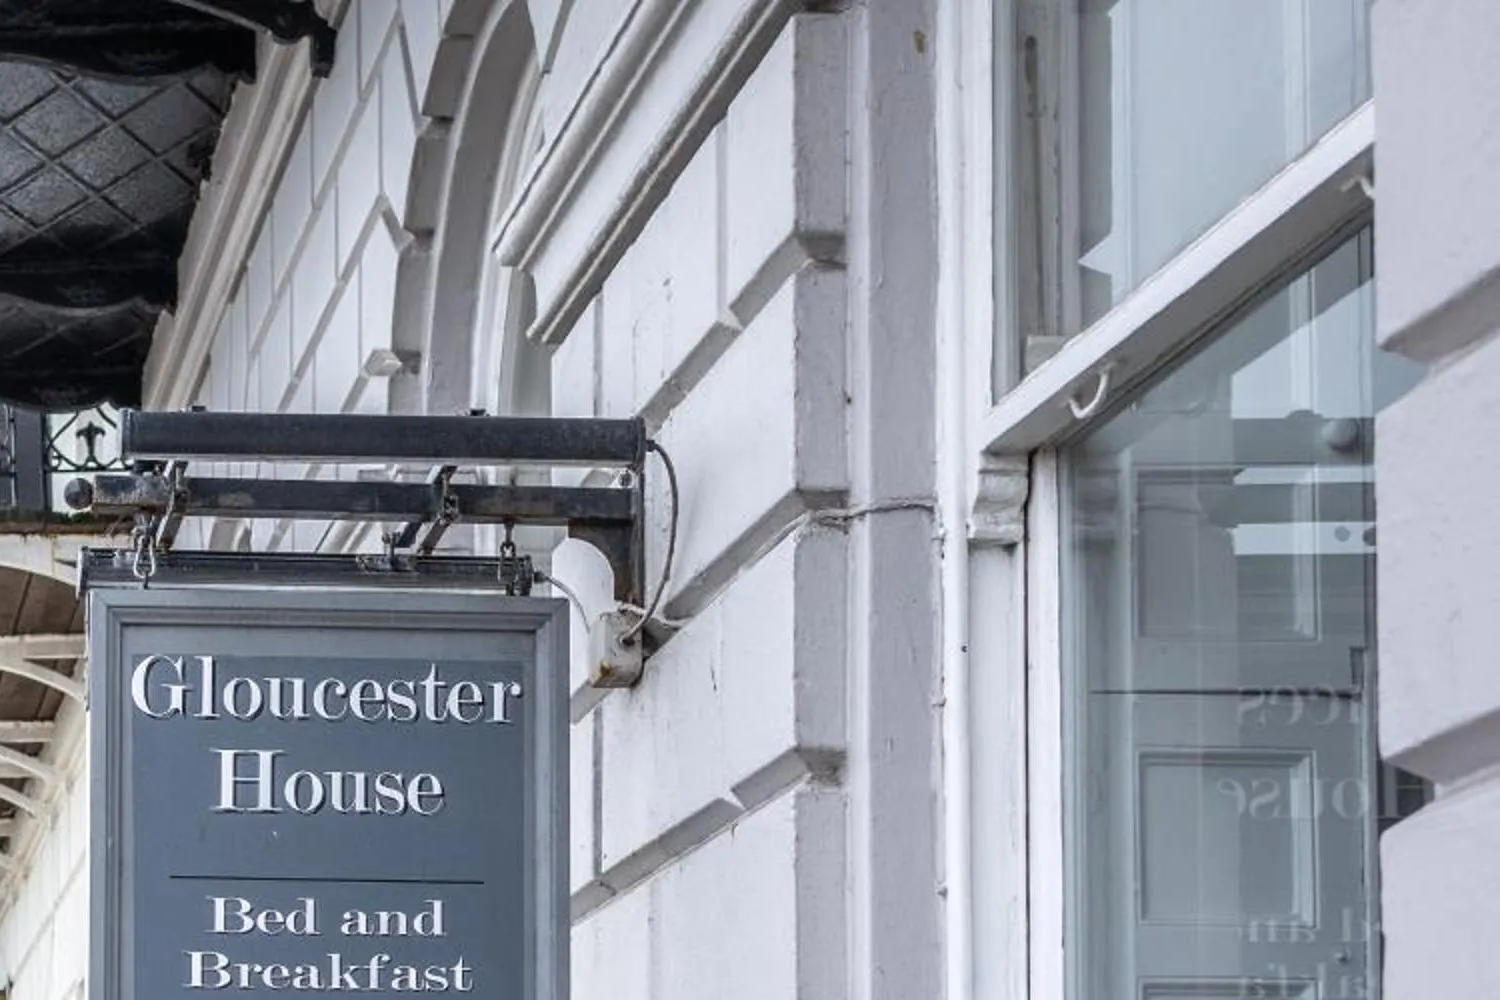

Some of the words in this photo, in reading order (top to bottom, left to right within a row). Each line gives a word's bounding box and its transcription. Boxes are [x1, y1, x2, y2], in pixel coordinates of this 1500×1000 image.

[131, 653, 522, 724] Gloucester
[209, 748, 444, 815] House
[205, 896, 321, 935] Bed
[340, 899, 447, 936] and
[181, 950, 473, 992] Breakfast
